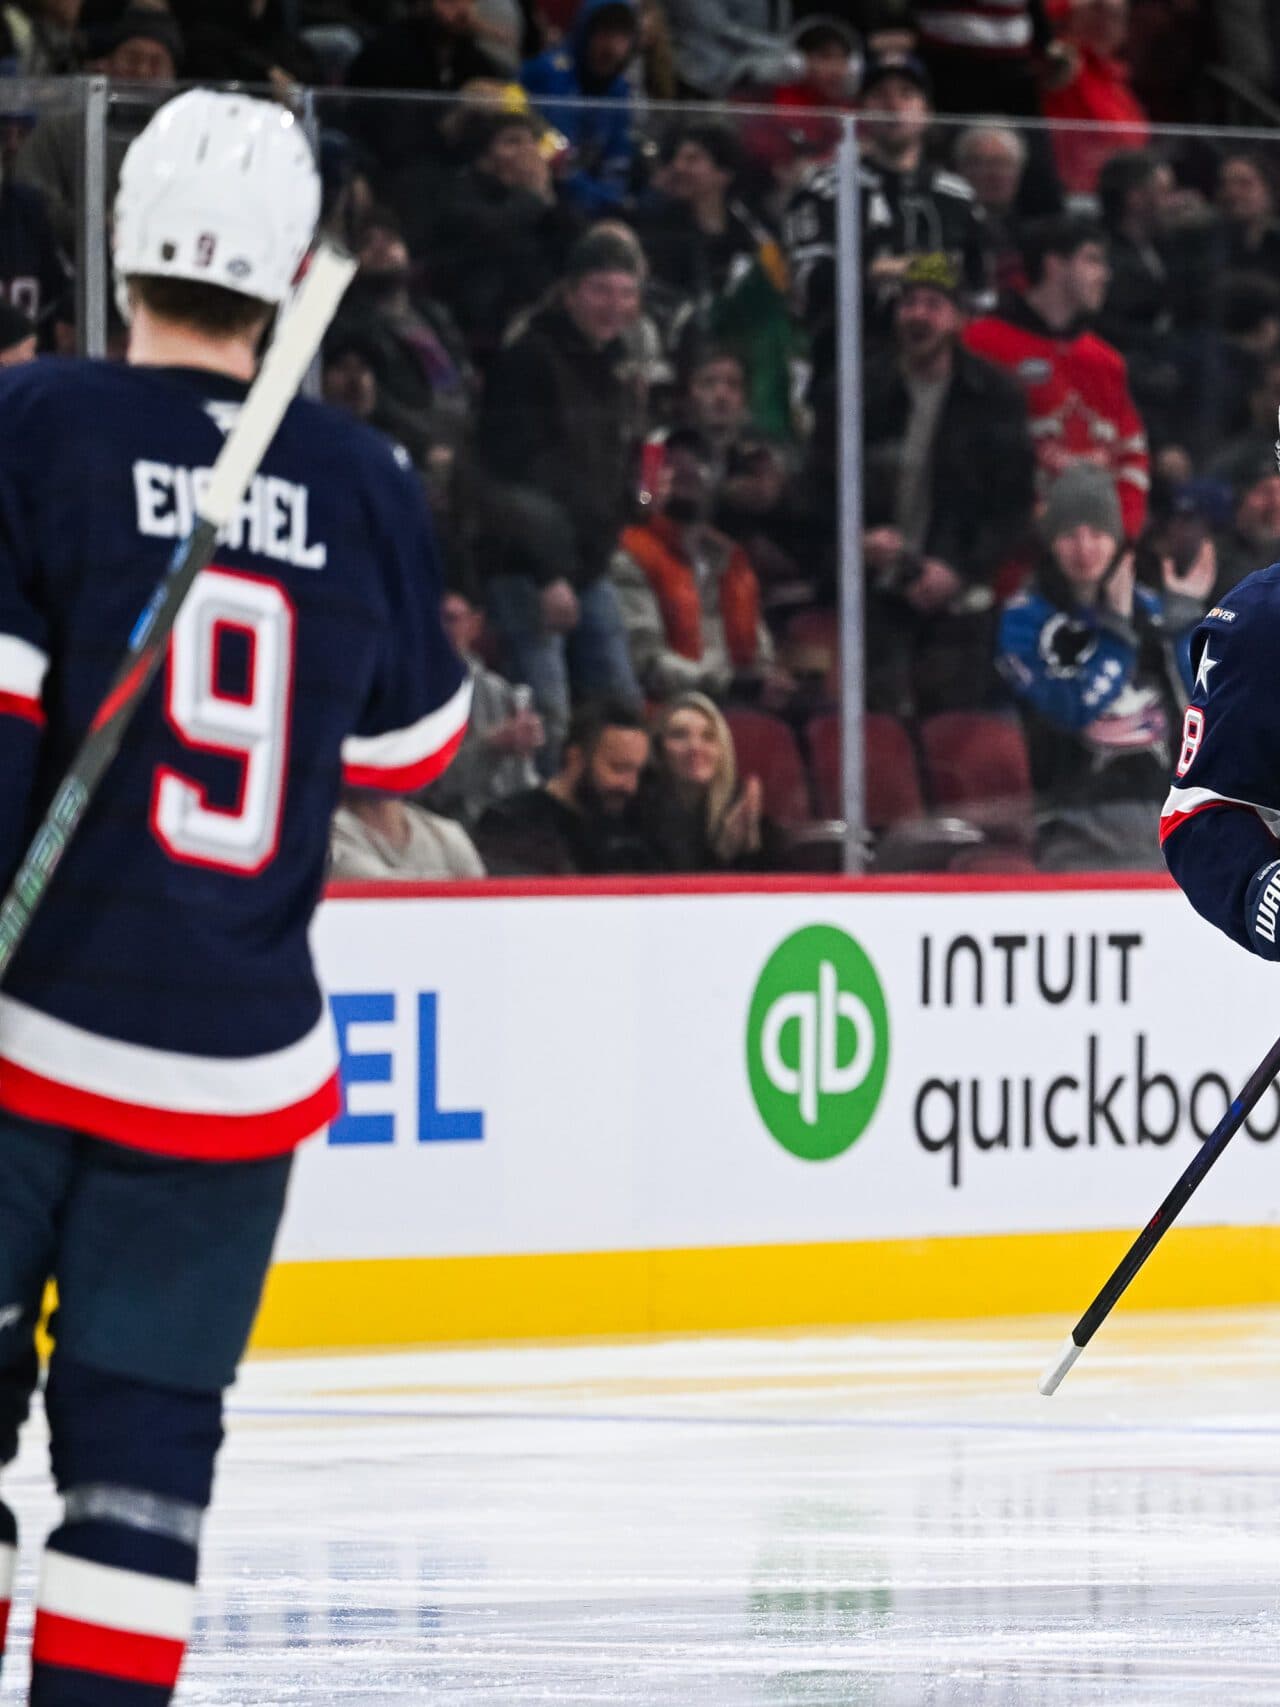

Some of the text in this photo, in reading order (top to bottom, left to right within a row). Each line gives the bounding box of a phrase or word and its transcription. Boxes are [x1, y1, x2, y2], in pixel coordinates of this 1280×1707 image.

[149, 566, 296, 879] 9
[1176, 704, 1206, 779] 8
[920, 932, 1145, 1007] INTUIT
